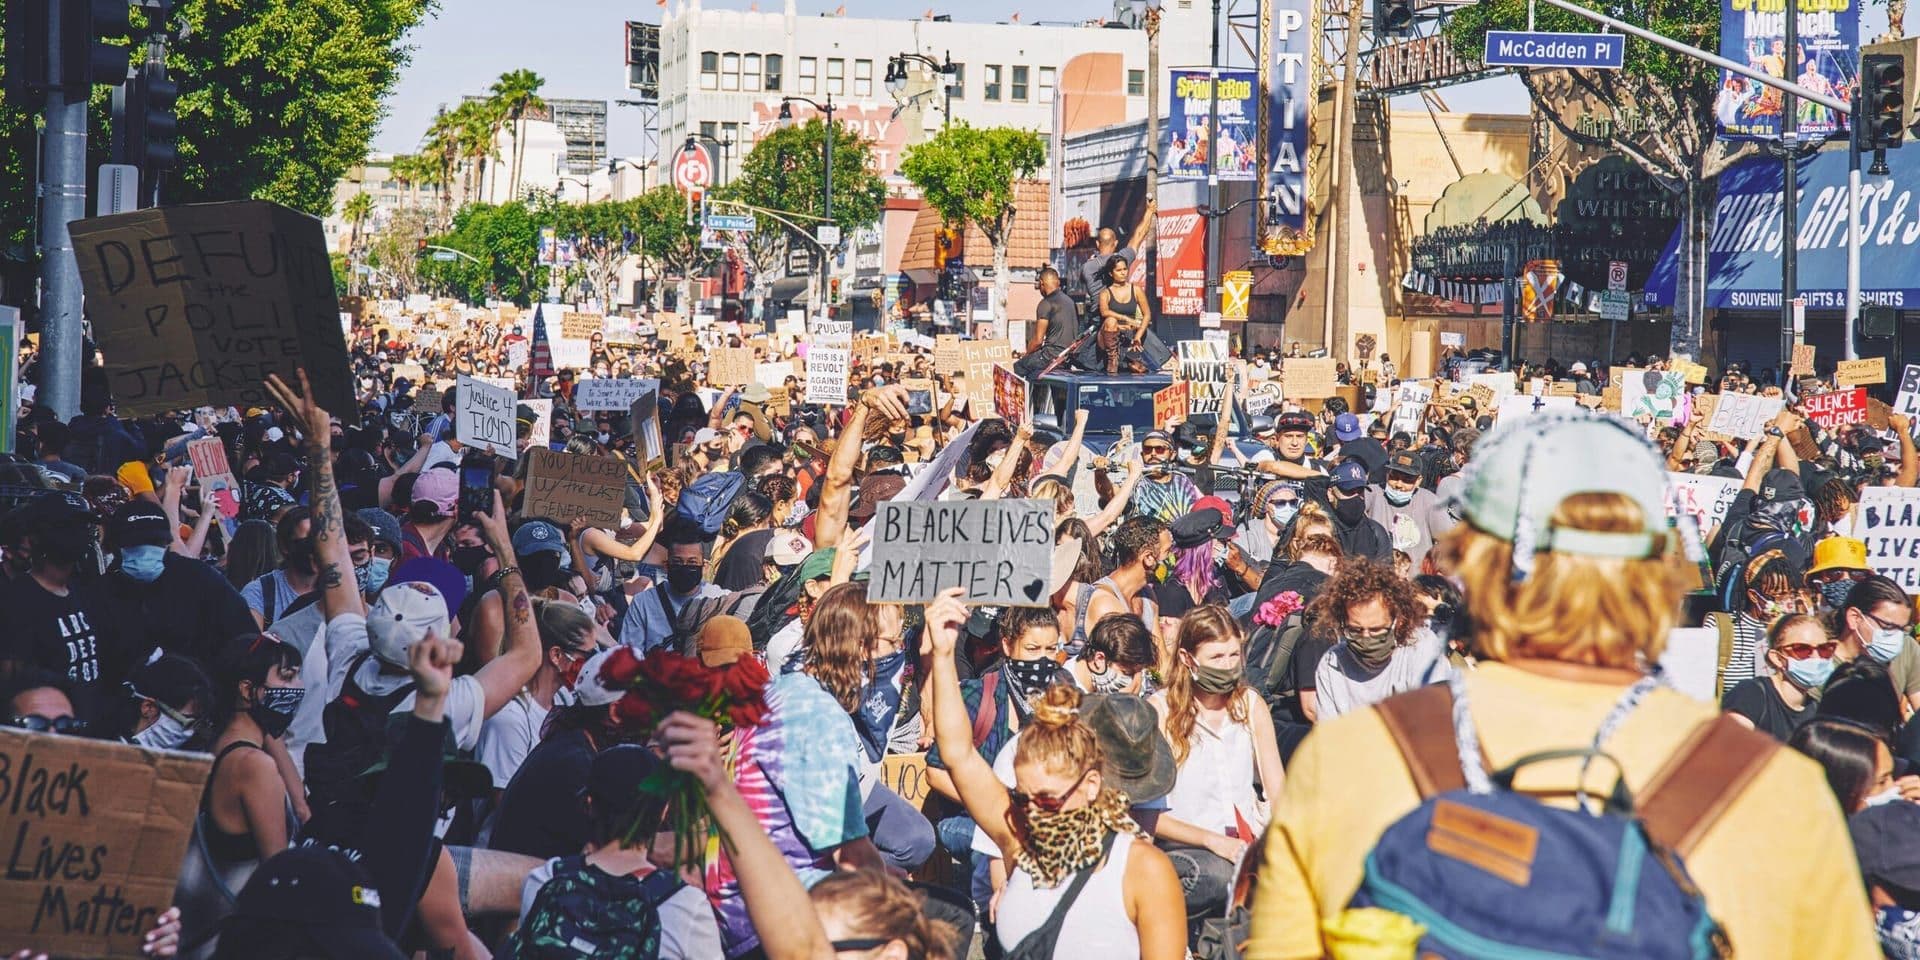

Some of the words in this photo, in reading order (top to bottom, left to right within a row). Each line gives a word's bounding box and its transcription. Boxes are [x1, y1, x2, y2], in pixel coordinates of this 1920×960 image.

[1499, 40, 1587, 59] McCadden
[1595, 43, 1611, 60] Pl
[1876, 191, 1911, 245] &
[210, 332, 303, 357] VOTE
[810, 353, 829, 361] THIS
[830, 353, 838, 362] IS
[839, 354, 845, 362] A
[984, 345, 1010, 359] NOT
[809, 376, 844, 385] AGAINST
[810, 362, 844, 374] REVOLT
[463, 383, 500, 412] Justice
[503, 397, 513, 418] 4
[812, 385, 842, 394] RACISM
[1806, 391, 1857, 413] SILENCE
[540, 451, 566, 470] YOU
[571, 456, 626, 478] FUCKED
[532, 499, 620, 522] GENERATION
[884, 506, 970, 544] BLACK
[982, 508, 1050, 545] LIVES
[881, 559, 1015, 599] MATTER
[67, 635, 97, 664] DEF
[0, 754, 90, 817] Black
[5, 820, 108, 882] Lives
[31, 884, 156, 936] Matter
